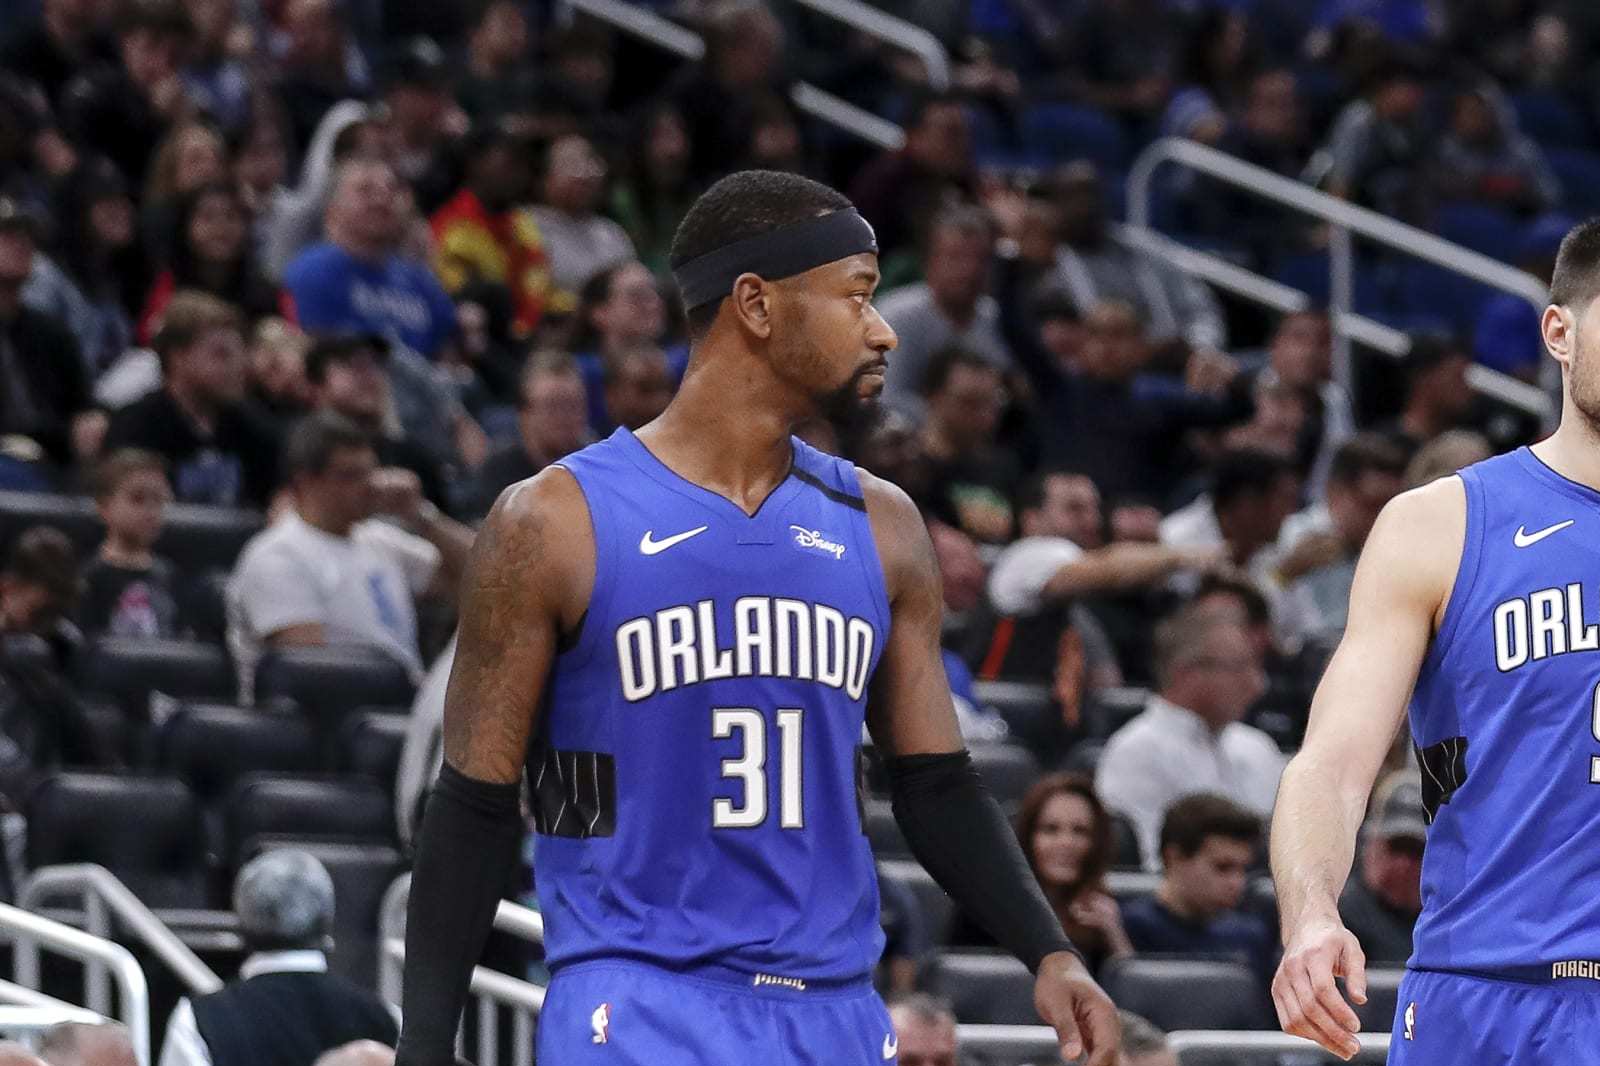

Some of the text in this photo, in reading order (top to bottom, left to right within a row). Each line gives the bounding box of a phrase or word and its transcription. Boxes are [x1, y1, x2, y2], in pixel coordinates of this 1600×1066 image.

[790, 525, 846, 560] Disney
[615, 596, 874, 703] ORLANDO
[712, 707, 804, 829] 31
